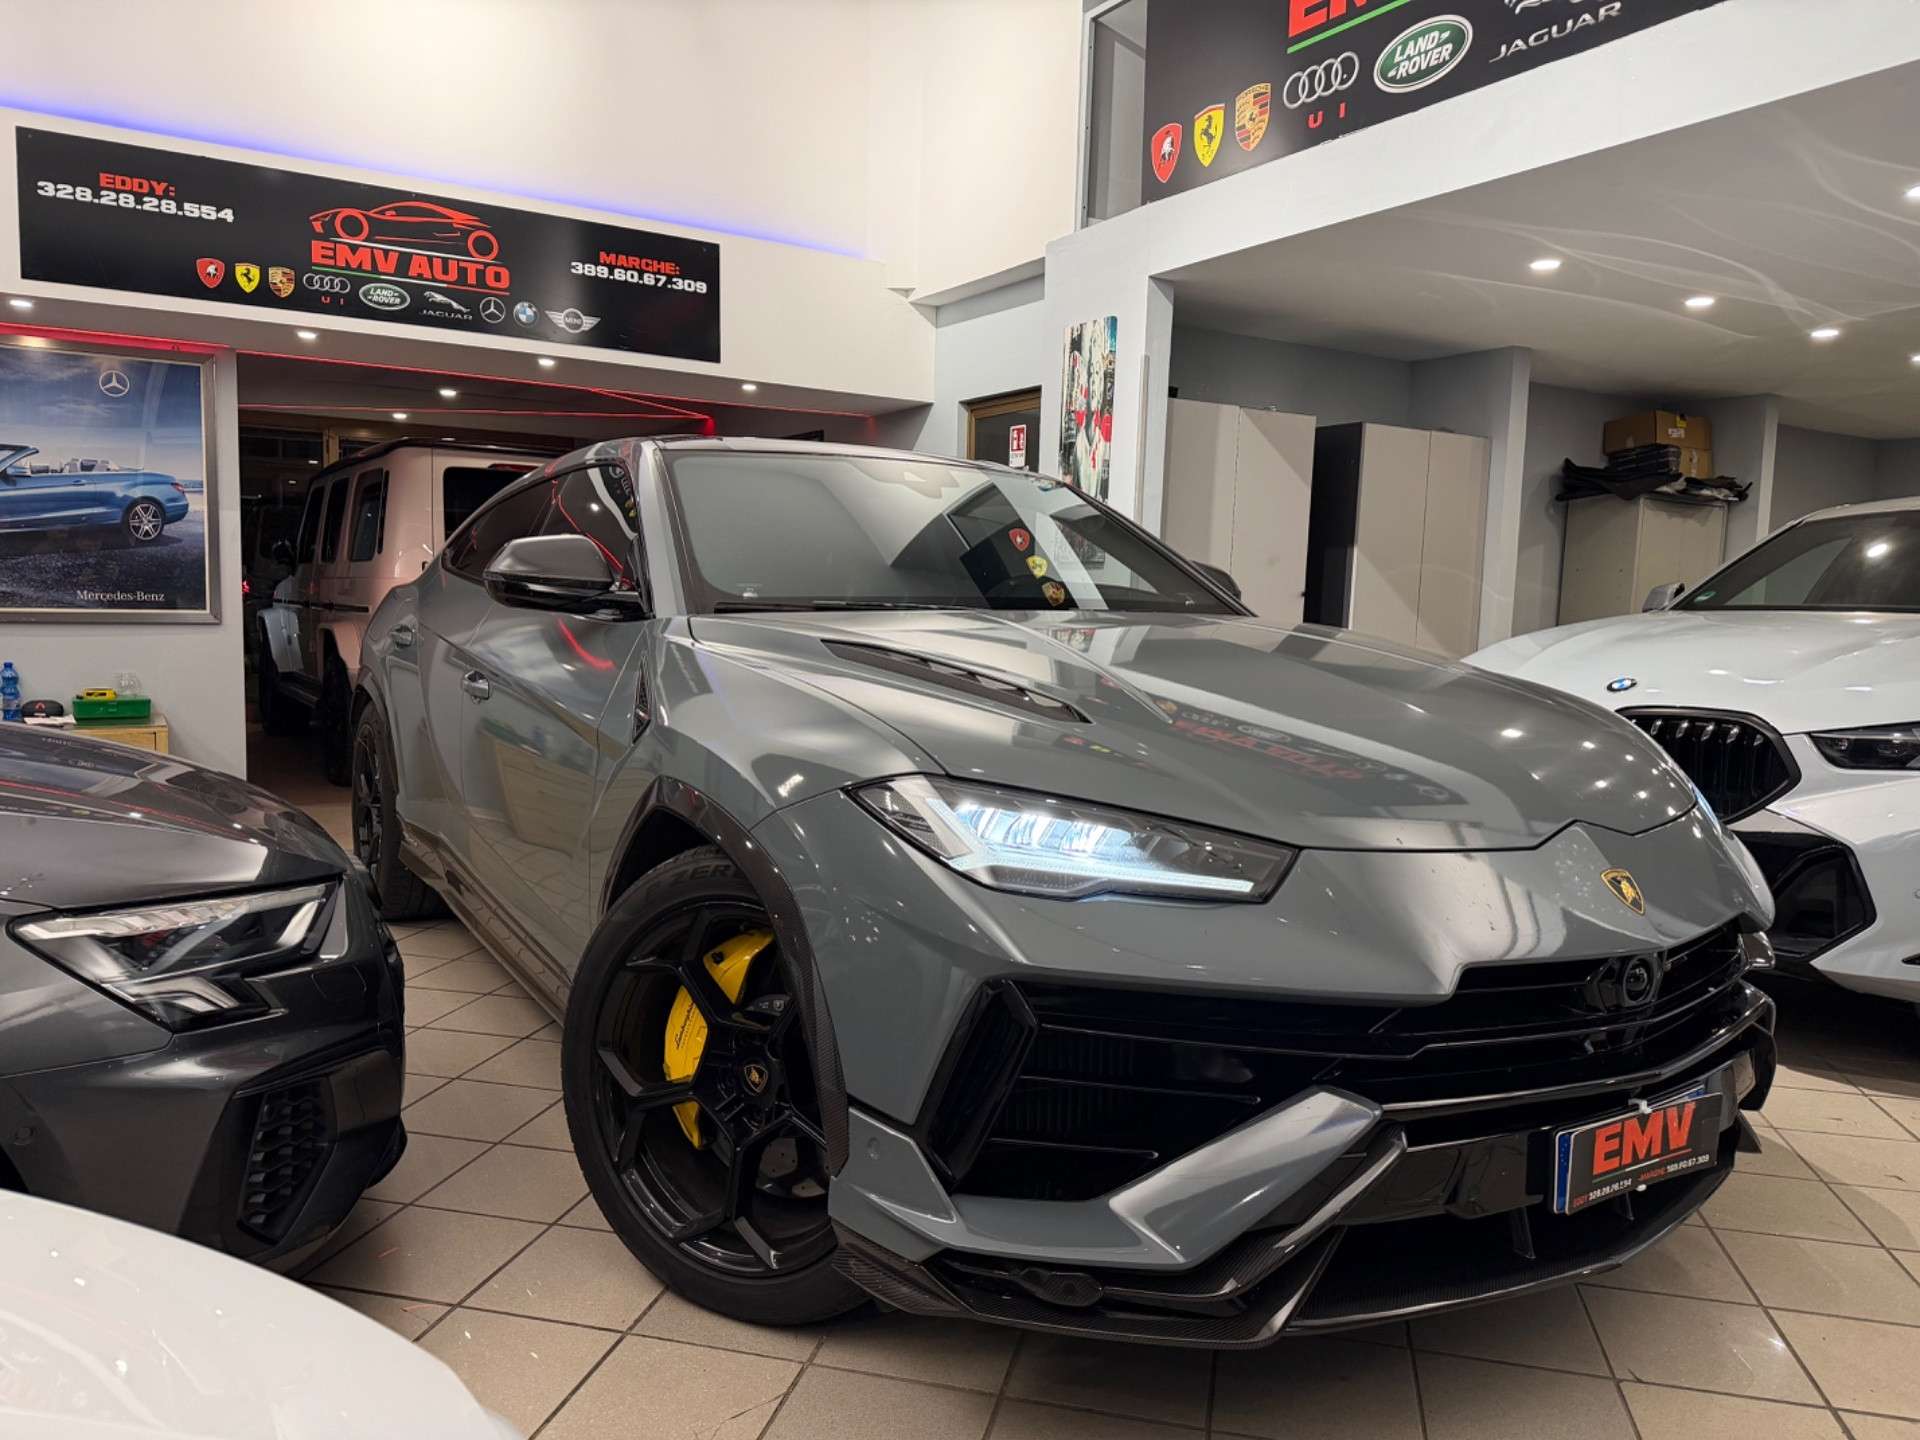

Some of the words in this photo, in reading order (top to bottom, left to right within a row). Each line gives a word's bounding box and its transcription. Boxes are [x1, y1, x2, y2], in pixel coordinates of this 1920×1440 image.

[1394, 30, 1440, 63] LAND
[1488, 1, 1622, 63] JAGUAR
[1396, 43, 1453, 79] ROVER
[1308, 110, 1323, 129] U
[99, 172, 176, 197] EDDY:
[36, 180, 235, 223] 328.28.28.554
[311, 239, 400, 274] EMV
[408, 253, 511, 289] AUTO
[570, 261, 708, 294] 389.60.67.309
[599, 251, 681, 275] MARCHE:
[370, 287, 394, 297] LAND
[419, 309, 473, 321] JAGUAR
[76, 589, 165, 602] Mercedes-Benz
[1592, 1101, 1697, 1176] EMV
